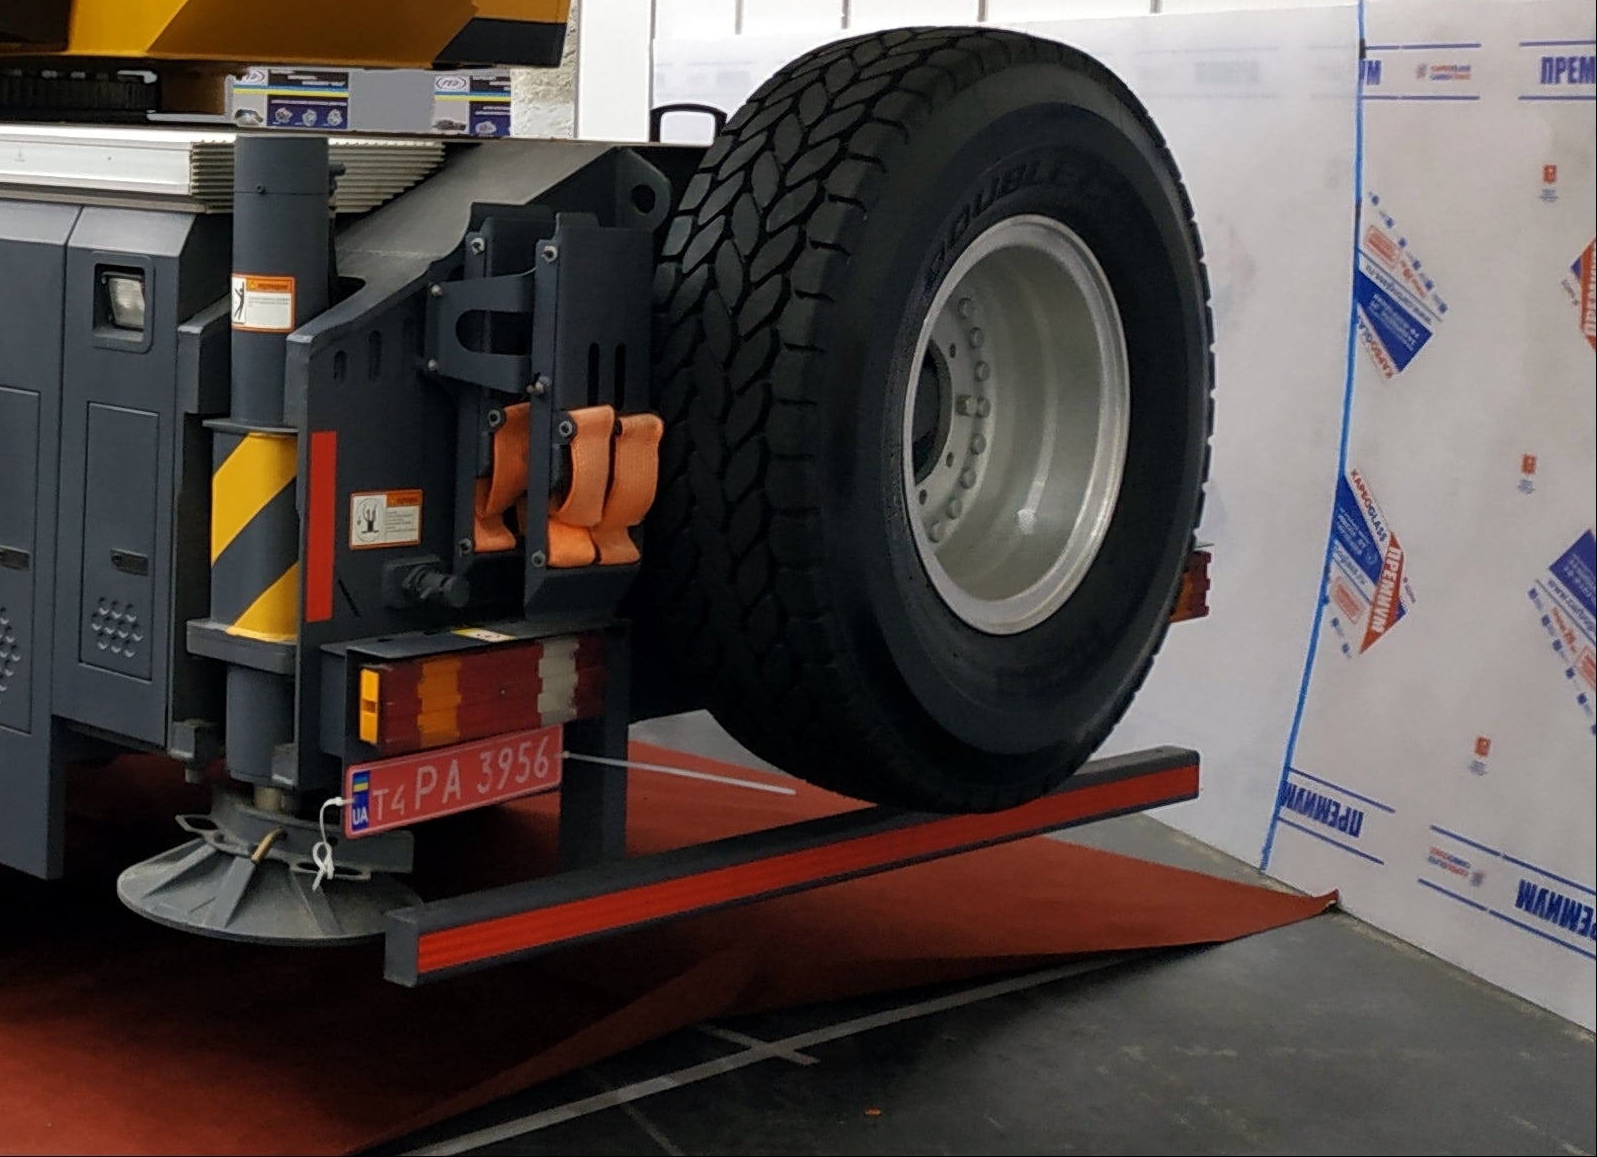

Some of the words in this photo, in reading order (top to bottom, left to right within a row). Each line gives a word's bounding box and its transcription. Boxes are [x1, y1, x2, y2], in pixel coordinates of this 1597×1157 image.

[1371, 545, 1402, 634] ПРЕМИУМ
[414, 760, 462, 811] PA
[475, 735, 551, 795] 3956
[352, 806, 369, 825] UA
